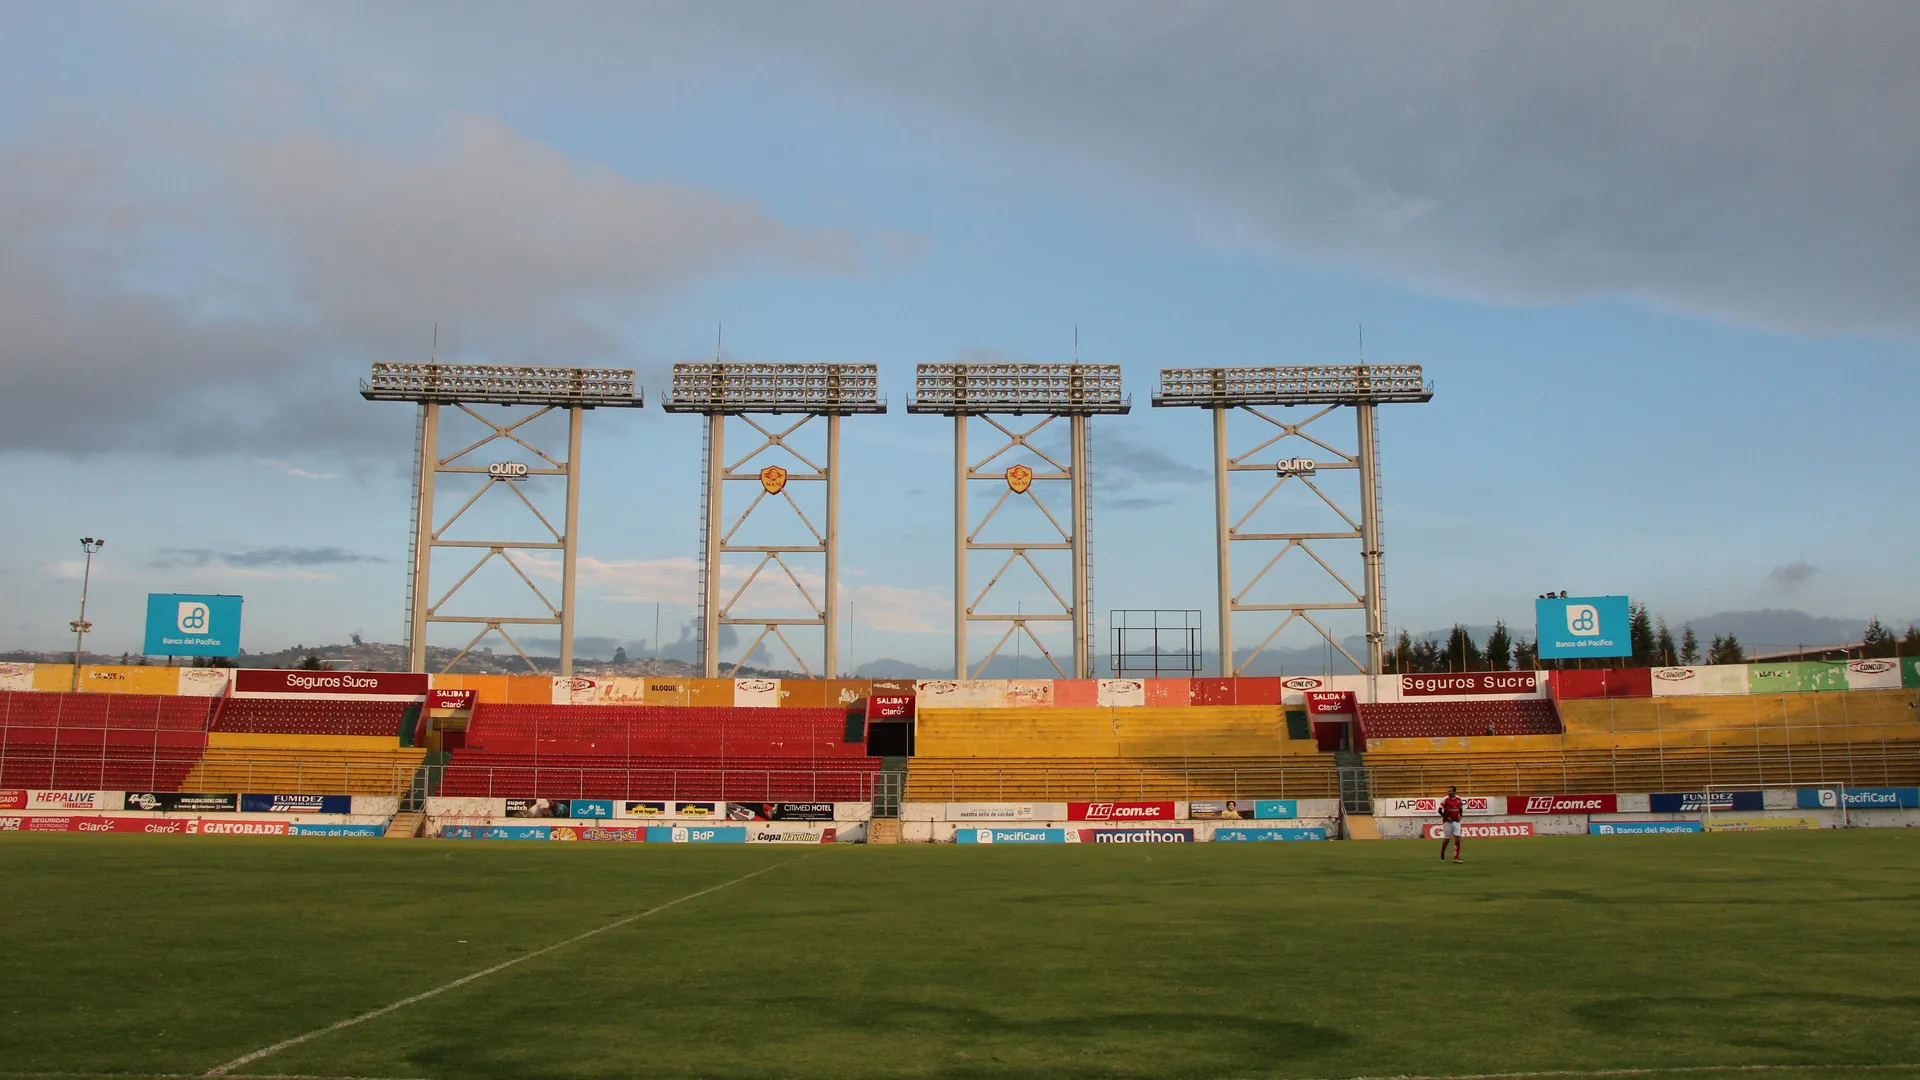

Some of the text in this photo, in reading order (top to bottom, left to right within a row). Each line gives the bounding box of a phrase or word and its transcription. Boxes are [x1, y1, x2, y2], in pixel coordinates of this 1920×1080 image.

[489, 461, 527, 474] QUITO
[1278, 457, 1315, 470] QUITO
[287, 674, 378, 689] Seguros Sucre
[1403, 676, 1535, 692] Seguros Sucre
[36, 792, 96, 802] HEPALIVE
[1842, 792, 1896, 802] PacifiCard
[1394, 799, 1436, 810] JAPON
[1462, 798, 1487, 809] PON
[78, 821, 110, 831] Claro
[145, 823, 176, 833] Claro
[204, 823, 283, 834] GATORADE
[1460, 826, 1529, 837] ATORADE
[693, 831, 714, 840] BdP
[758, 832, 820, 842] Copa Havoline
[997, 832, 1045, 841] PacifiCard
[1096, 830, 1185, 843] marathon
